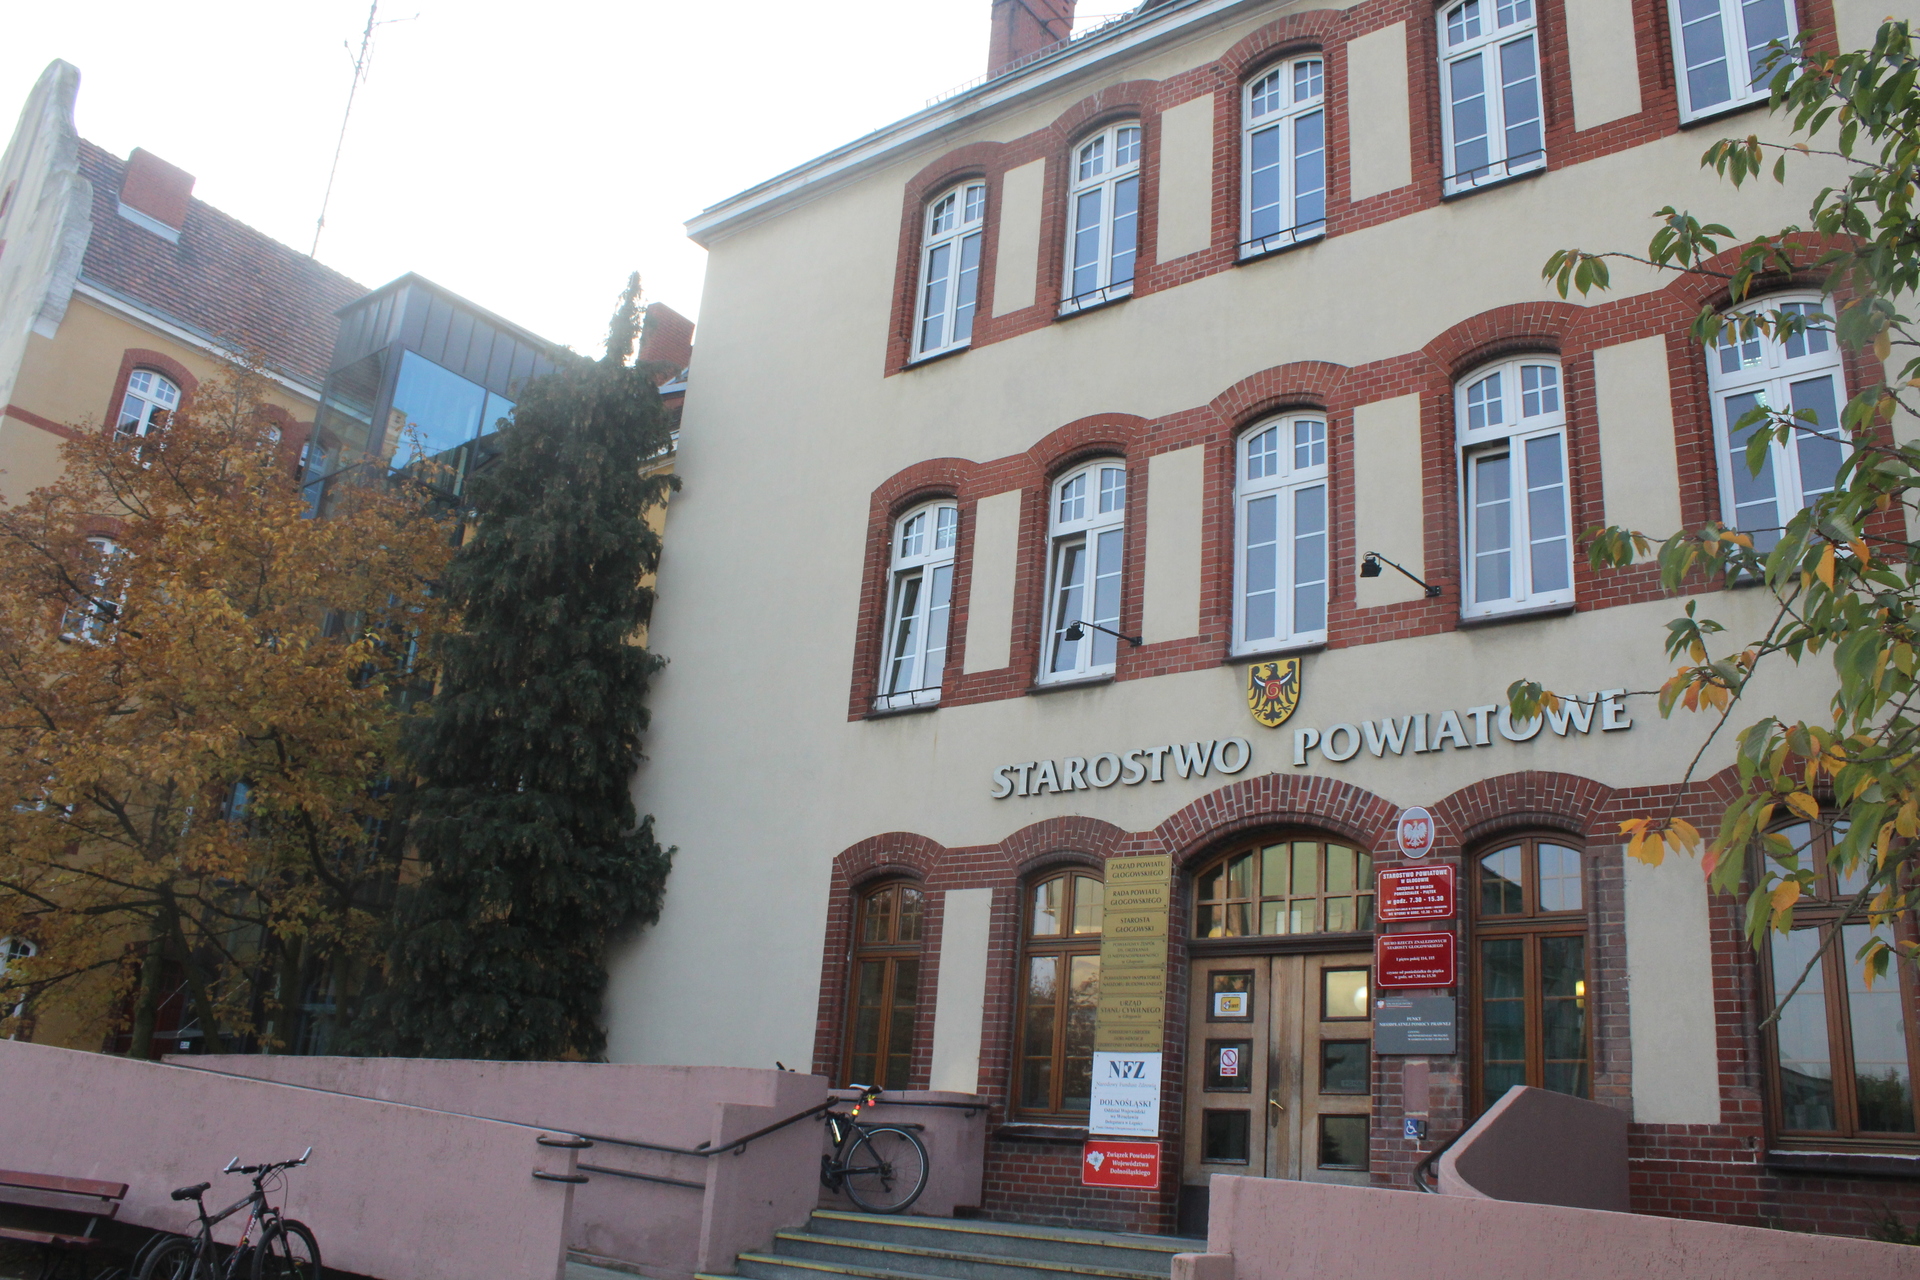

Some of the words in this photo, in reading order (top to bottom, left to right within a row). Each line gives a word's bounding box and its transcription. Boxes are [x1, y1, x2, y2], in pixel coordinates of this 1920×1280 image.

[990, 736, 1252, 799] STAROSTWO
[1293, 688, 1633, 766] POWIATOWE
[1112, 870, 1164, 878] GŁOGOWSKIEGO
[1110, 897, 1162, 906] GŁOGOWSKIEGO
[1108, 1060, 1146, 1079] NFZ
[1099, 1098, 1151, 1108] DOLNOŚLĄSKI
[1110, 1168, 1150, 1177] Dolnośląskiego
